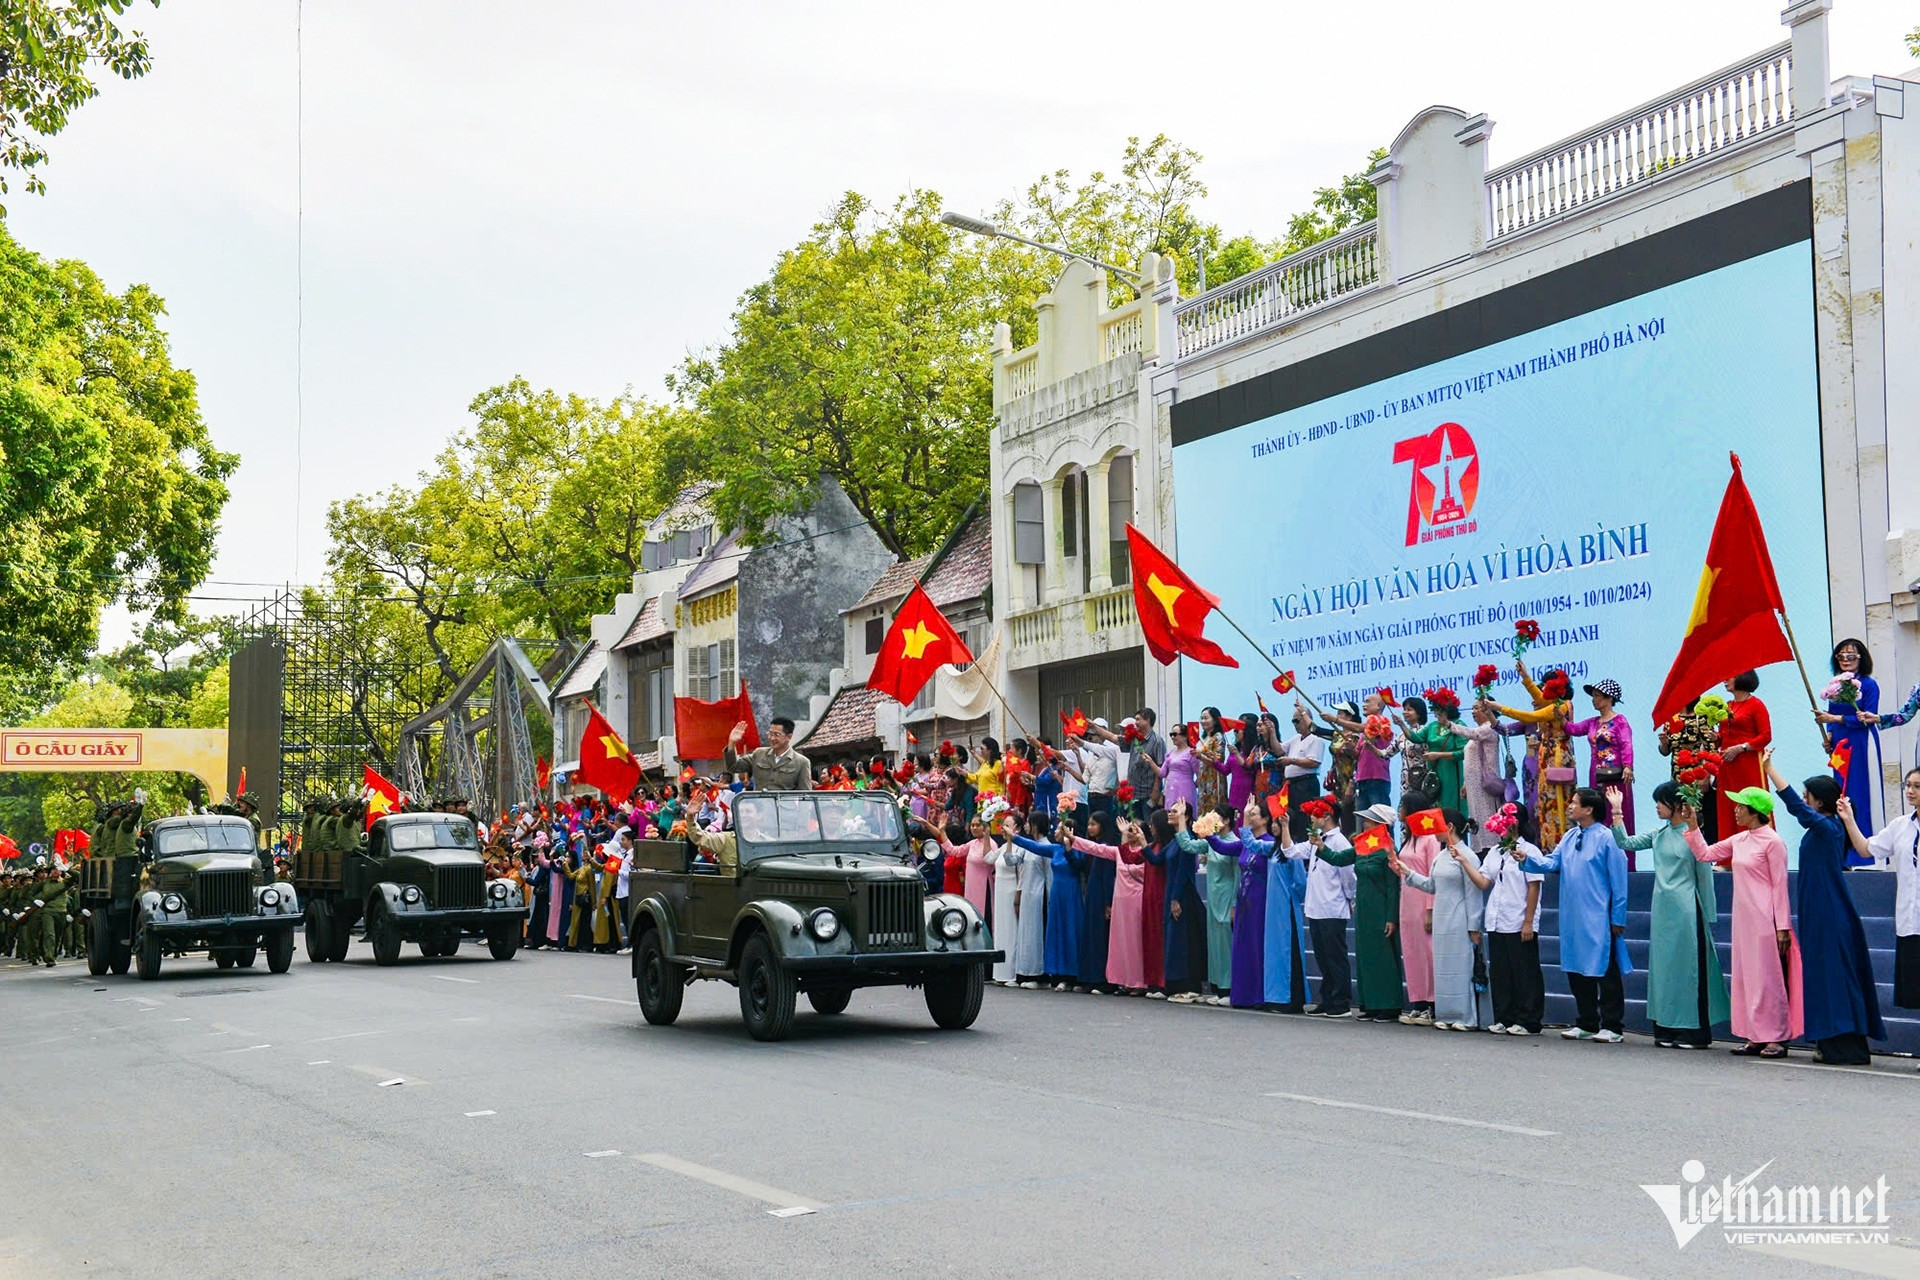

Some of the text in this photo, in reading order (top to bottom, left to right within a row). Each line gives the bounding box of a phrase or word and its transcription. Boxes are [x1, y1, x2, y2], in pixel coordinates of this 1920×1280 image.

[1251, 437, 1286, 458] THÀNH
[1287, 429, 1302, 448] ỦY
[1308, 420, 1338, 442] HĐND
[1345, 409, 1375, 430] UBND
[1383, 400, 1400, 419] ỦY
[1401, 393, 1425, 413] BAN
[1427, 381, 1462, 405] MTTQ
[1464, 371, 1495, 393] VIỆT
[1497, 361, 1527, 385] NAM
[1529, 346, 1577, 374] THÀNH
[1580, 330, 1610, 359] PHỐ
[1613, 323, 1634, 349] HÀ
[1638, 317, 1666, 342] NỘI
[1392, 421, 1480, 547] 70
[1421, 528, 1434, 543] GIẢI
[1434, 525, 1454, 541] PHÓNG
[1272, 522, 1649, 623] NGÀY HỘI VĂN HÓA VÌ HÒA BÌNH
[1288, 637, 1314, 657] NIỆM
[1316, 635, 1326, 651] 70
[1328, 629, 1352, 649] NĂM
[1354, 623, 1385, 645] NGÀY
[1387, 618, 1412, 639] GIẢI
[1415, 612, 1456, 635] PHÓNG
[1458, 604, 1484, 627] THỦ
[1487, 601, 1506, 623] ĐÔ
[1508, 594, 1571, 622] (10/10/1954
[1583, 580, 1651, 608] 10/10/2024)
[1307, 666, 1318, 680] 25
[1319, 660, 1344, 679] NĂM
[1345, 654, 1368, 674] THỦ
[1370, 651, 1386, 671] ĐÔ
[1389, 649, 1405, 669] HÀ
[1408, 647, 1429, 669] NỘI
[1431, 643, 1467, 664] ĐƯỢC
[1525, 630, 1557, 649] NH
[1560, 623, 1600, 645] DANH
[1401, 677, 1425, 698] HÒA
[15, 740, 129, 756] Ô CẦU GIẤY
